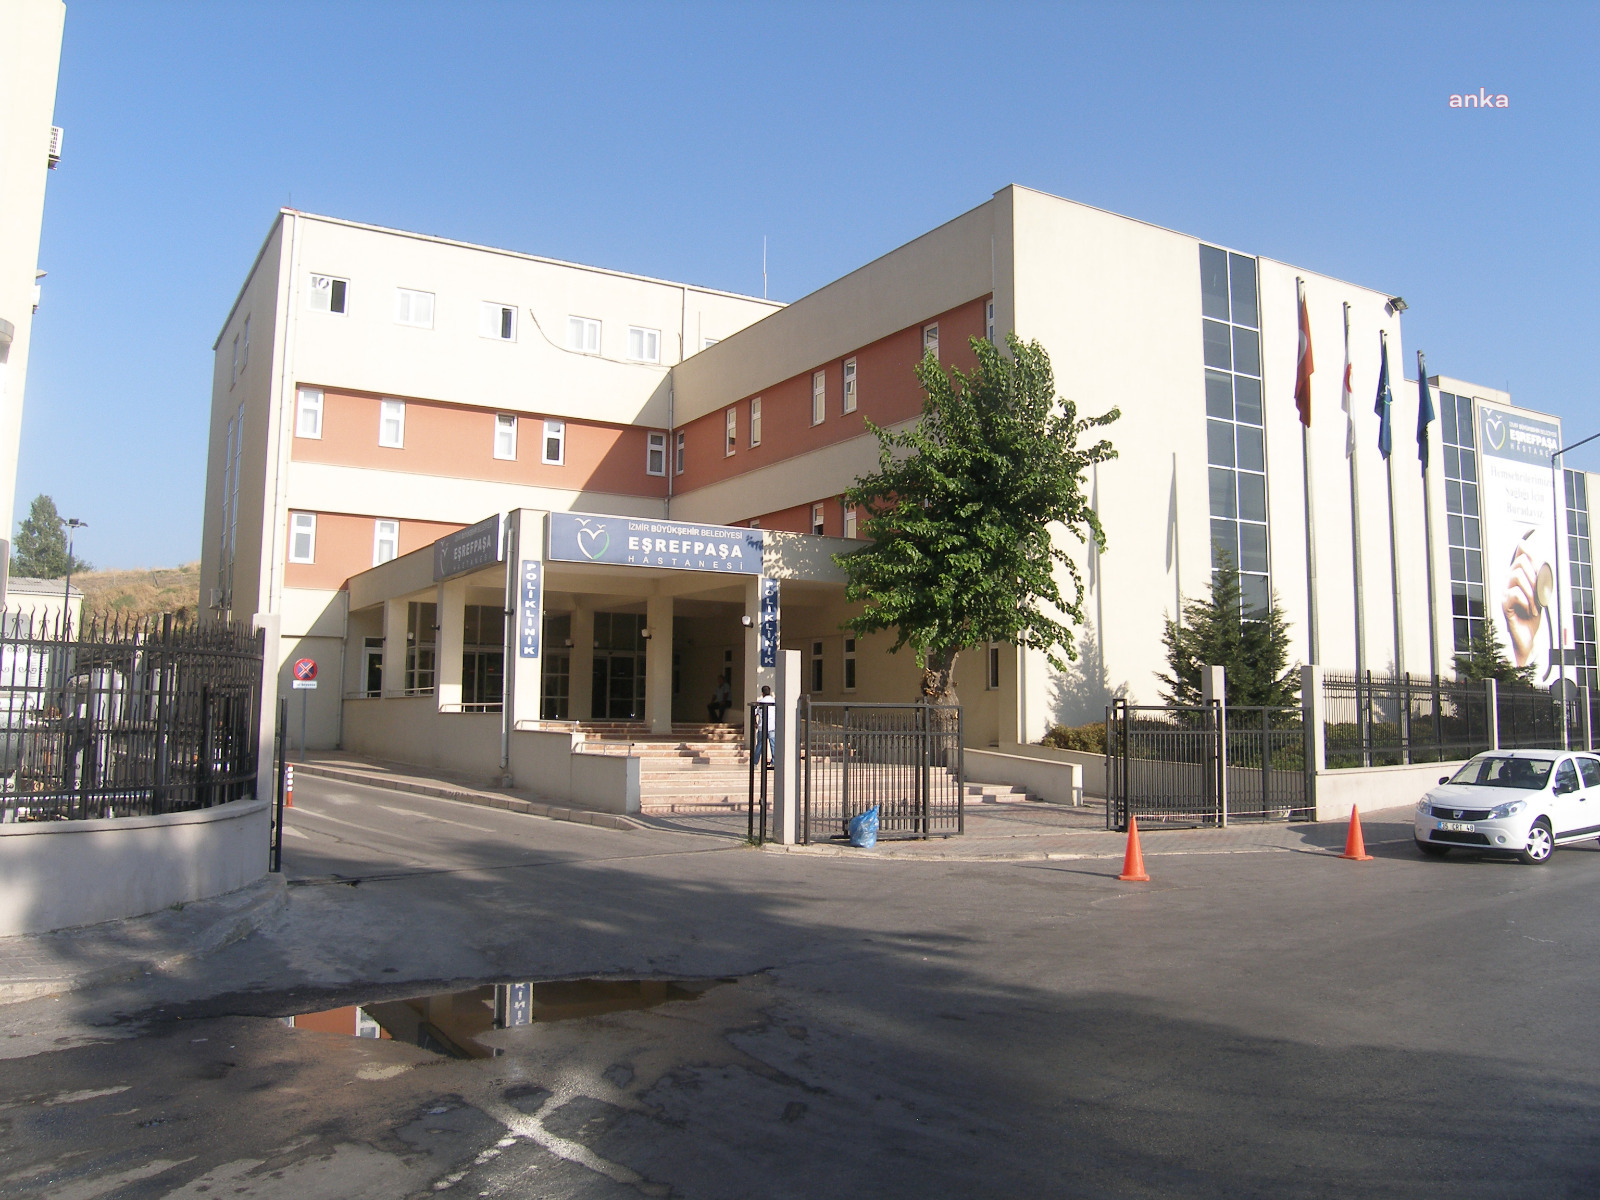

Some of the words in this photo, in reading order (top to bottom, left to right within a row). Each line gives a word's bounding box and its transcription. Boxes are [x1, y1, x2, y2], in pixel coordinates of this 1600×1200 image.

[628, 521, 650, 532] İZMİR
[650, 525, 700, 536] BÜYÜKŞEHİR
[700, 530, 743, 540] BELEDİYESİ
[454, 534, 492, 562] EŞREFPAŞA
[628, 536, 743, 560] EŞREFPAŞA
[628, 555, 743, 570] HASTANESİ
[523, 563, 537, 655] POLİKLİNİK
[764, 581, 775, 664] POLİKLİNİK
